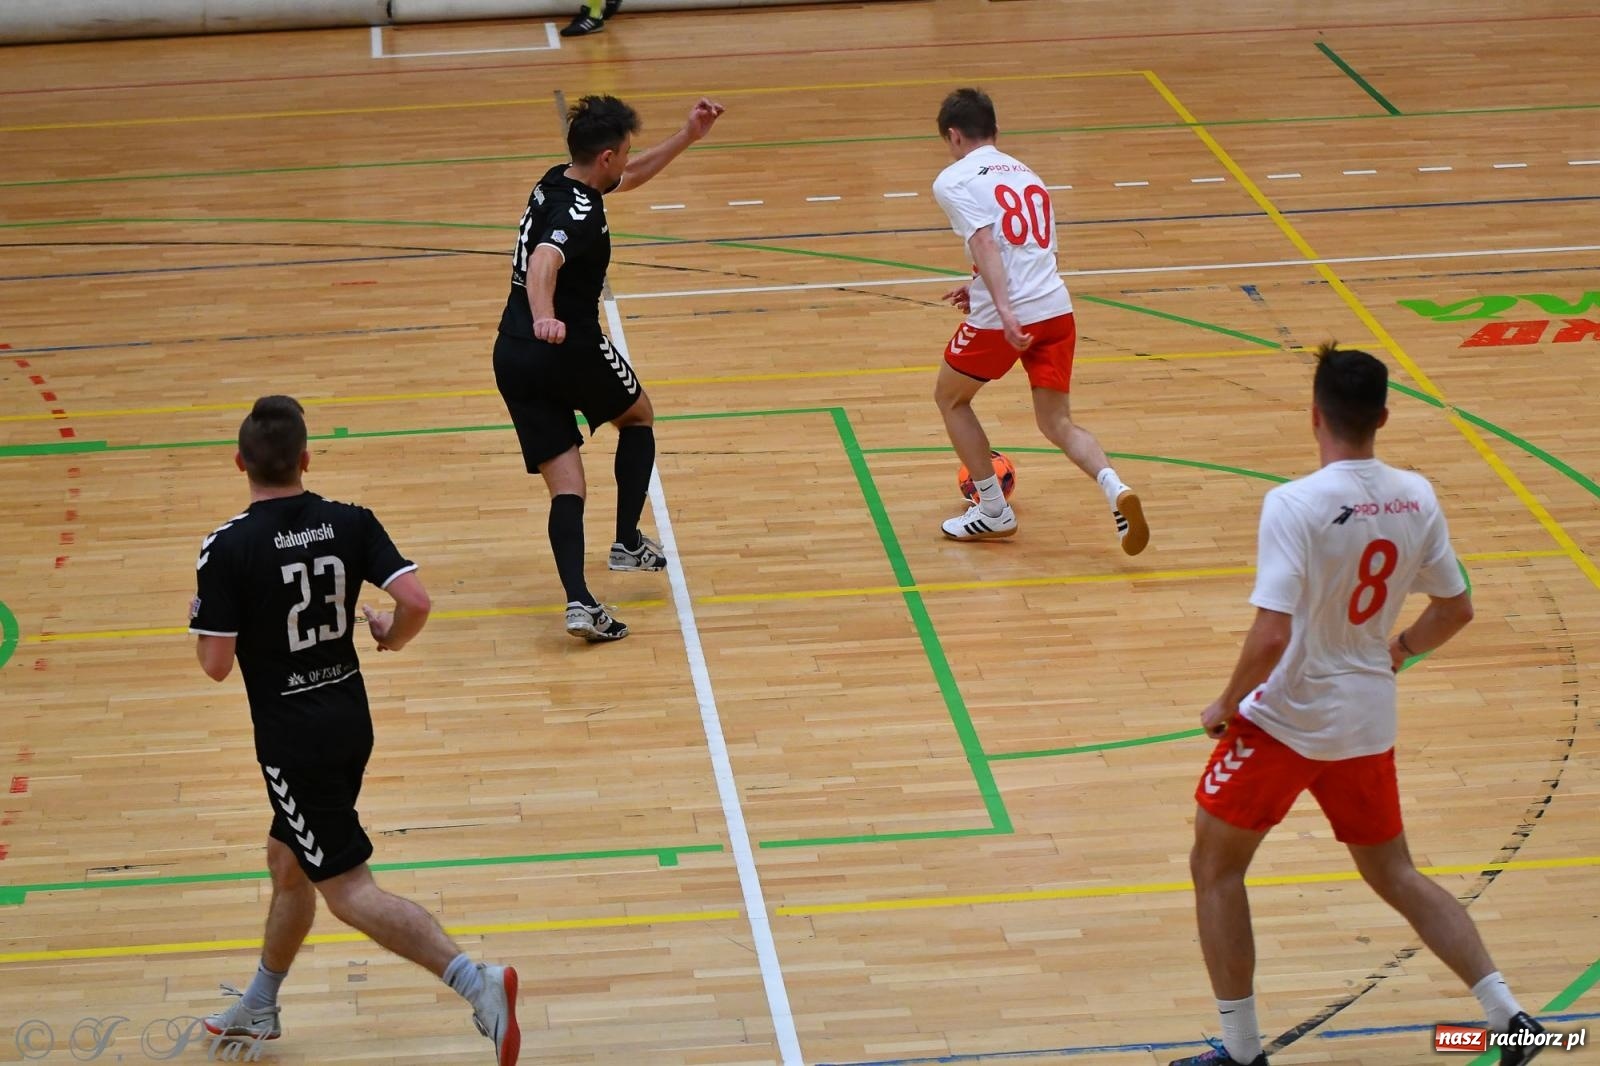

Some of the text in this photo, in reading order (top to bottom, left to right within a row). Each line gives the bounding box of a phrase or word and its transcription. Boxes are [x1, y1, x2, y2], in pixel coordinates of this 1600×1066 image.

[994, 184, 1051, 249] 80
[1383, 499, 1420, 515] KÜHN
[280, 555, 348, 653] 23
[1348, 538, 1398, 626] 8
